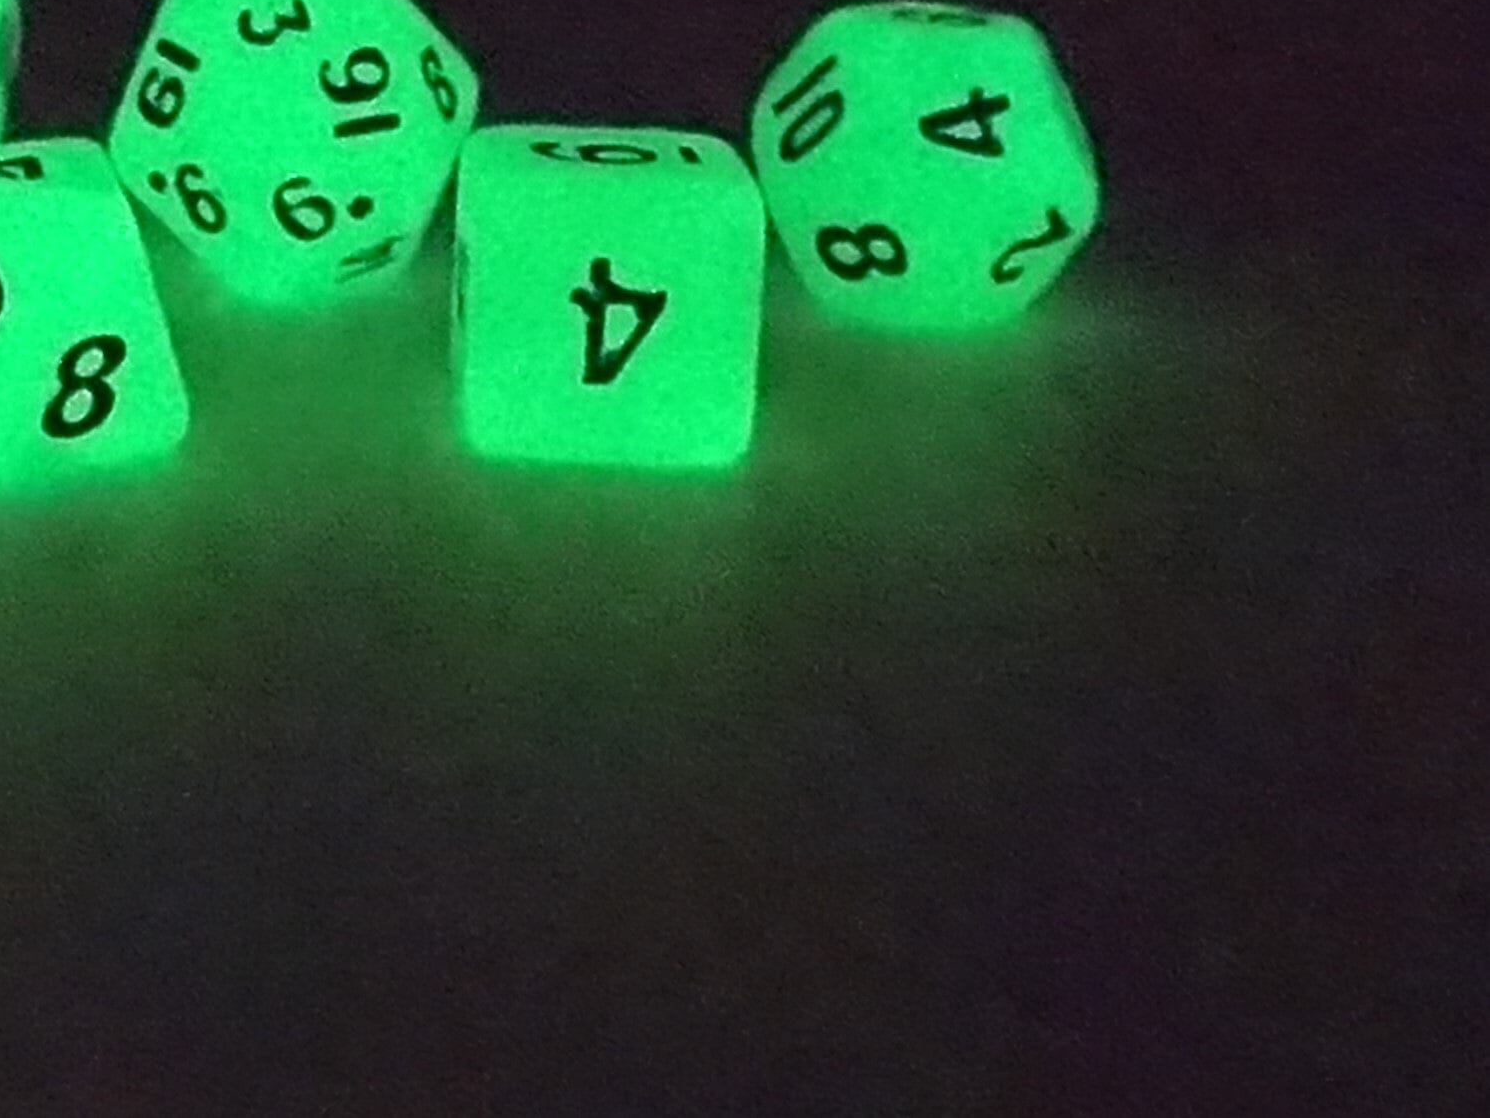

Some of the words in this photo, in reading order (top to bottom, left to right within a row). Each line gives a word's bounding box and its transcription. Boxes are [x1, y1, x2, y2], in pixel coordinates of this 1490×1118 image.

[138, 38, 201, 128] 19
[318, 46, 401, 139] 16
[772, 54, 845, 164] 10
[918, 87, 1010, 158] 4
[815, 223, 908, 282] 8
[990, 206, 1073, 285] 2
[569, 256, 668, 385] 4
[41, 334, 128, 440] 8
